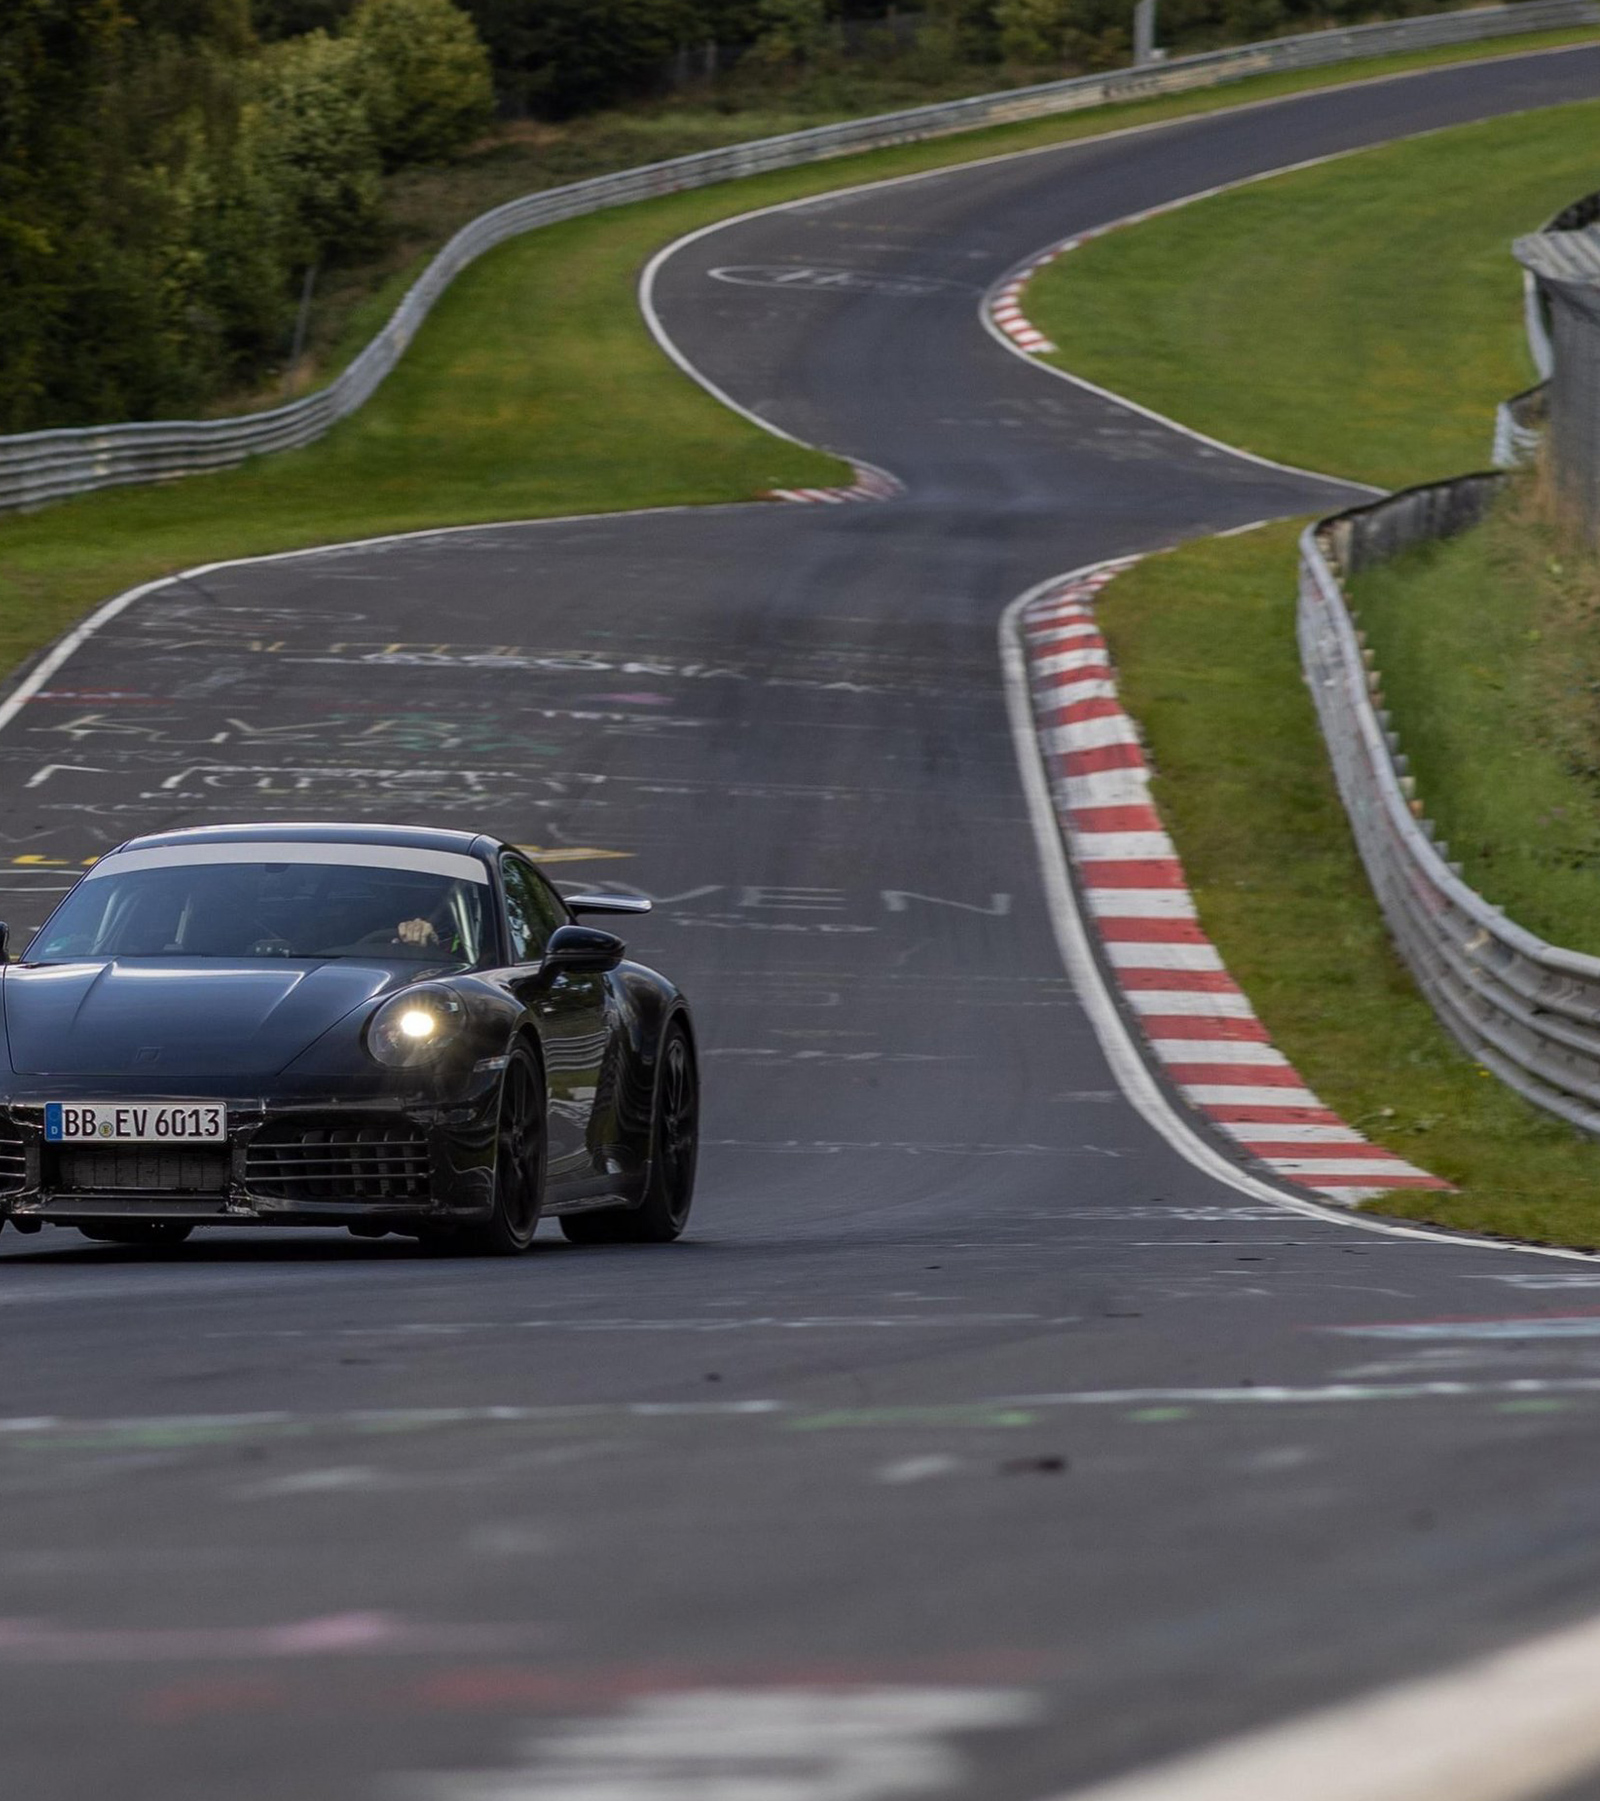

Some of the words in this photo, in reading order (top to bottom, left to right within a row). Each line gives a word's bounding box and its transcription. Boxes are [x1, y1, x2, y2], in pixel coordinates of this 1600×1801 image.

[64, 1109, 97, 1137] BB
[115, 1109, 148, 1137] EV
[155, 1109, 220, 1137] 6013
